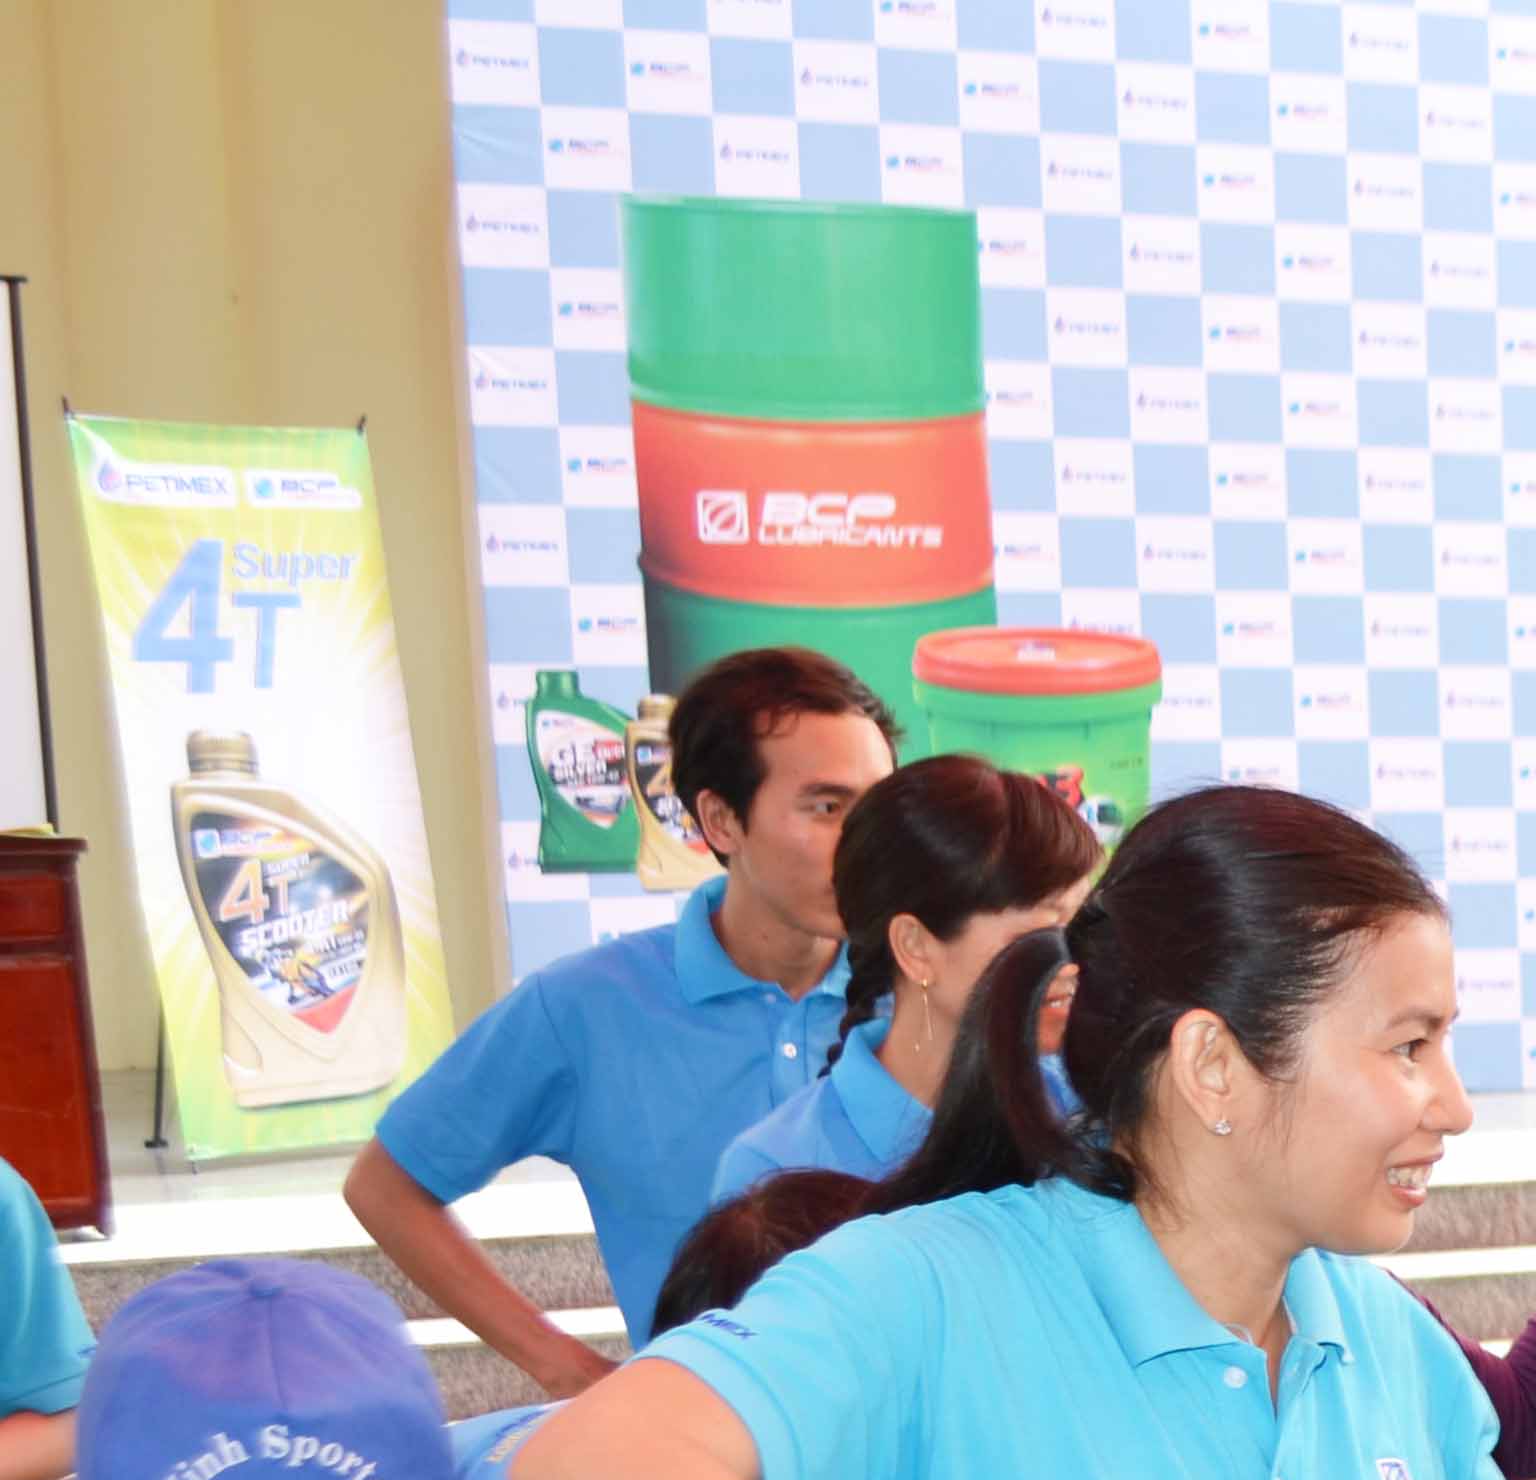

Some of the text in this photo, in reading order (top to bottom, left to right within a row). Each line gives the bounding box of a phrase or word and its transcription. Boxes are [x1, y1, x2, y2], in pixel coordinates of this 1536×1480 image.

[761, 491, 897, 527] BCP
[757, 523, 944, 549] LUBRICANTS
[232, 543, 355, 585] Super
